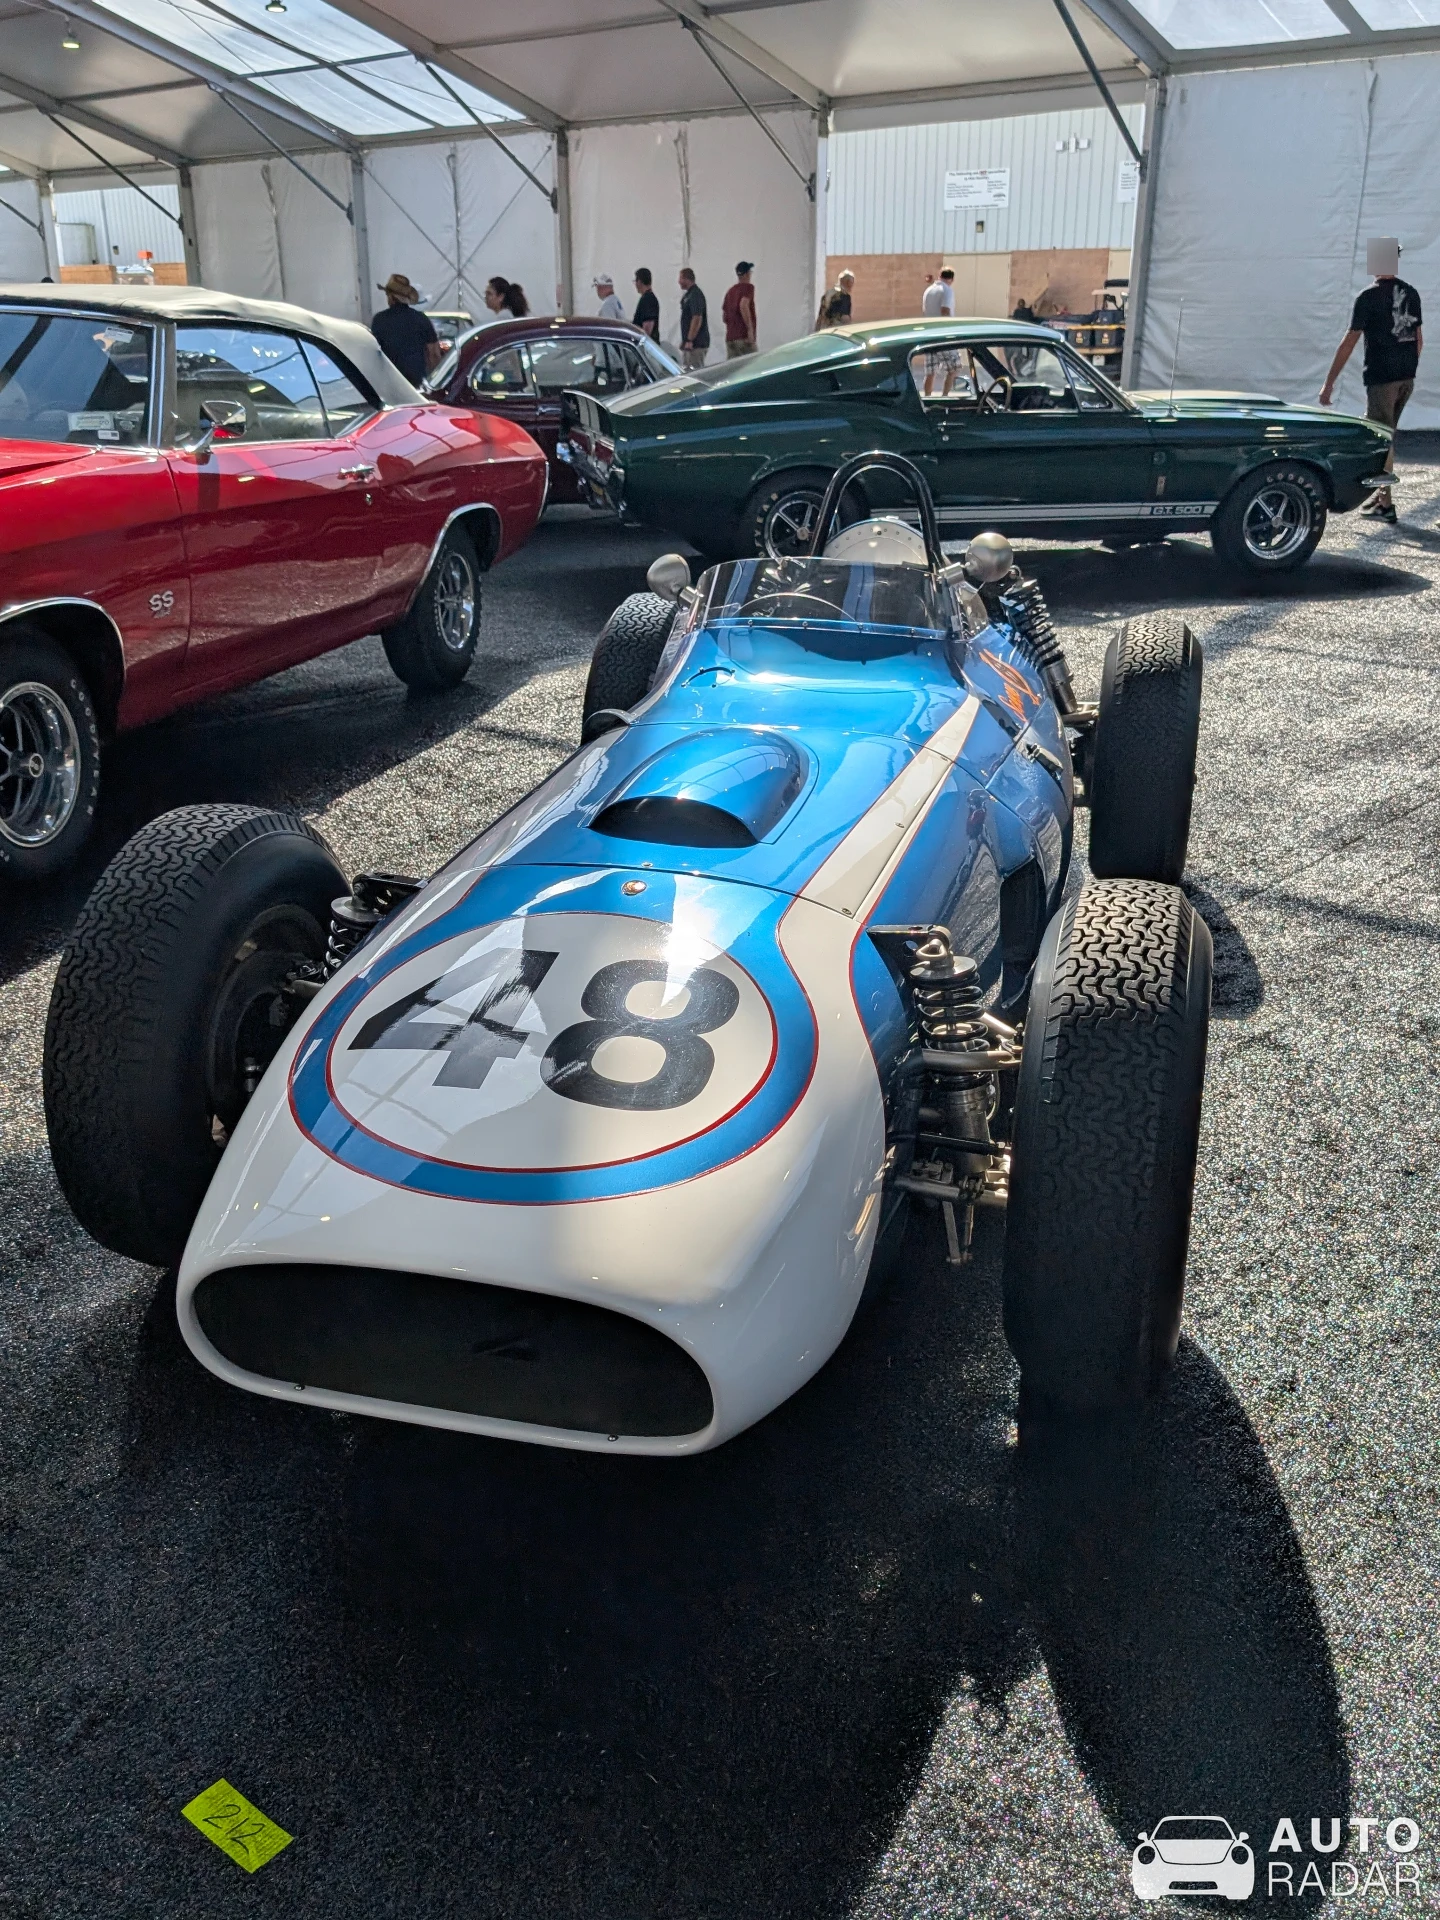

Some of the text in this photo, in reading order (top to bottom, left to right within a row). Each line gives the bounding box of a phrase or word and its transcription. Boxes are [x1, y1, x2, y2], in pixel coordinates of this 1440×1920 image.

[149, 590, 174, 611] SS
[347, 947, 740, 1111] 48
[202, 1803, 266, 1856] 212
